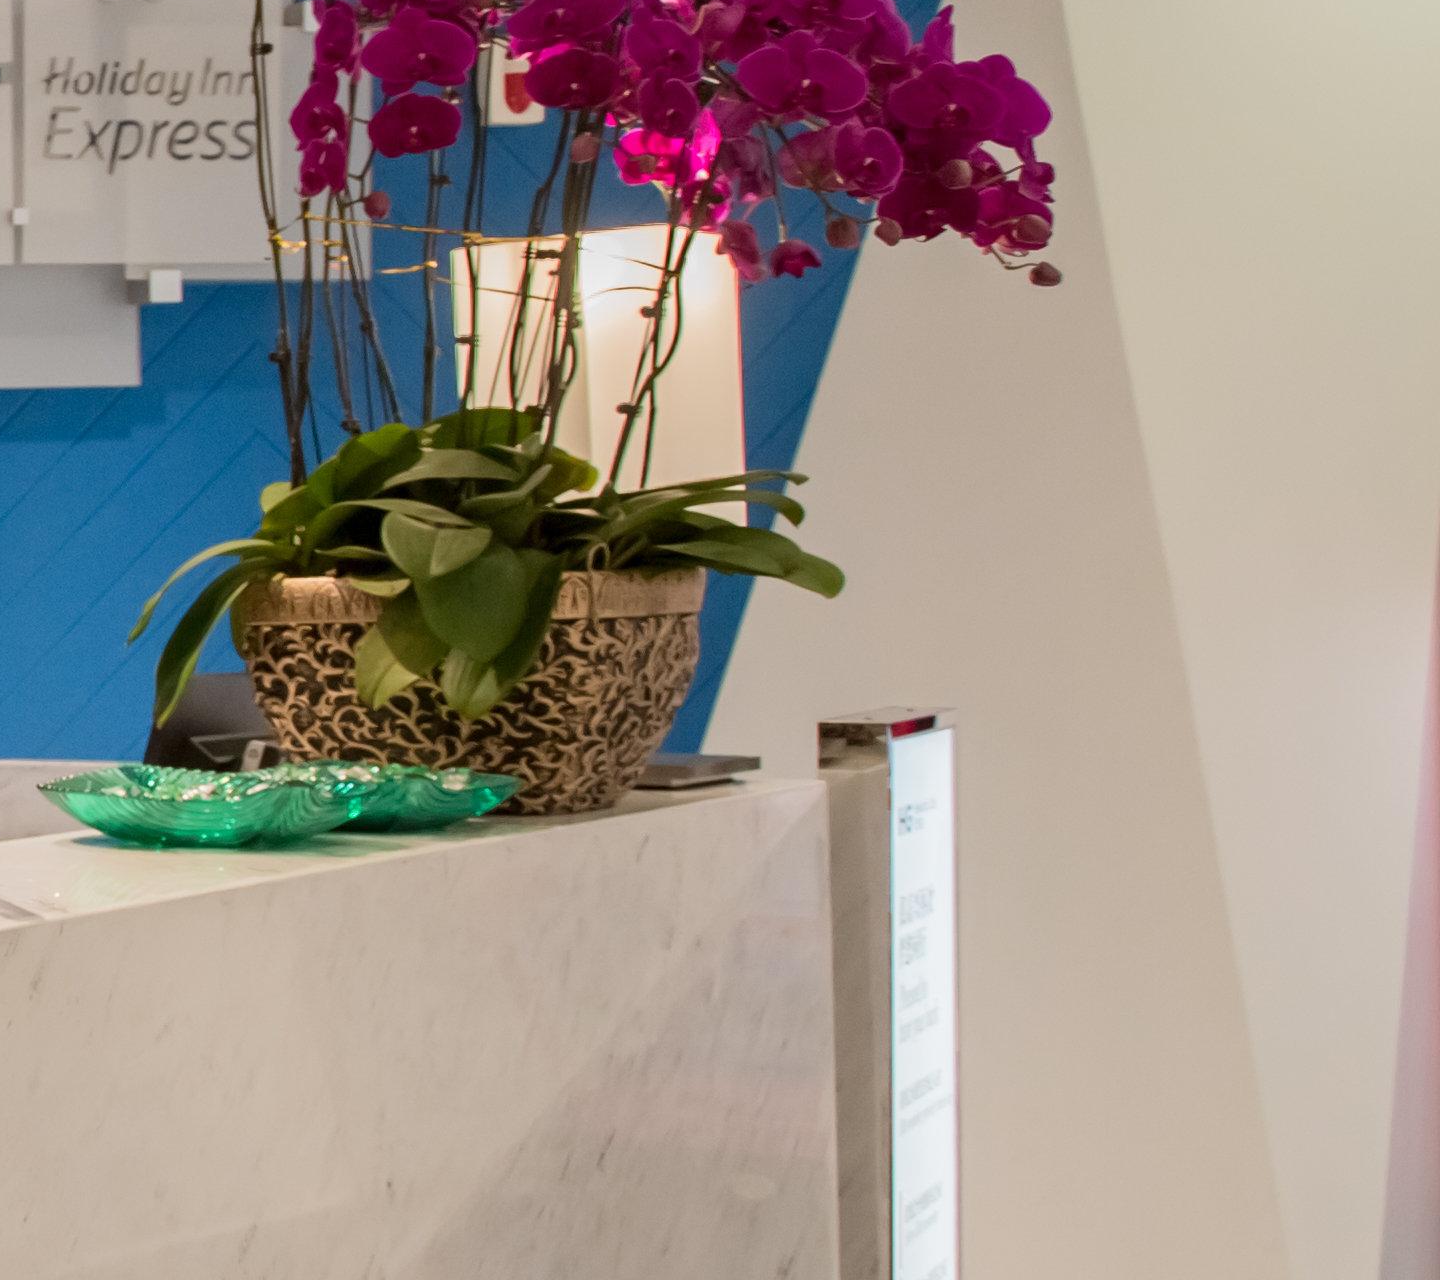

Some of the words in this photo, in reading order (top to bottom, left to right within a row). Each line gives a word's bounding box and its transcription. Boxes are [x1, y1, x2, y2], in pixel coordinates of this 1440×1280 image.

[43, 56, 192, 106] Holiday
[200, 57, 258, 96] Inn
[43, 105, 259, 175] Express
